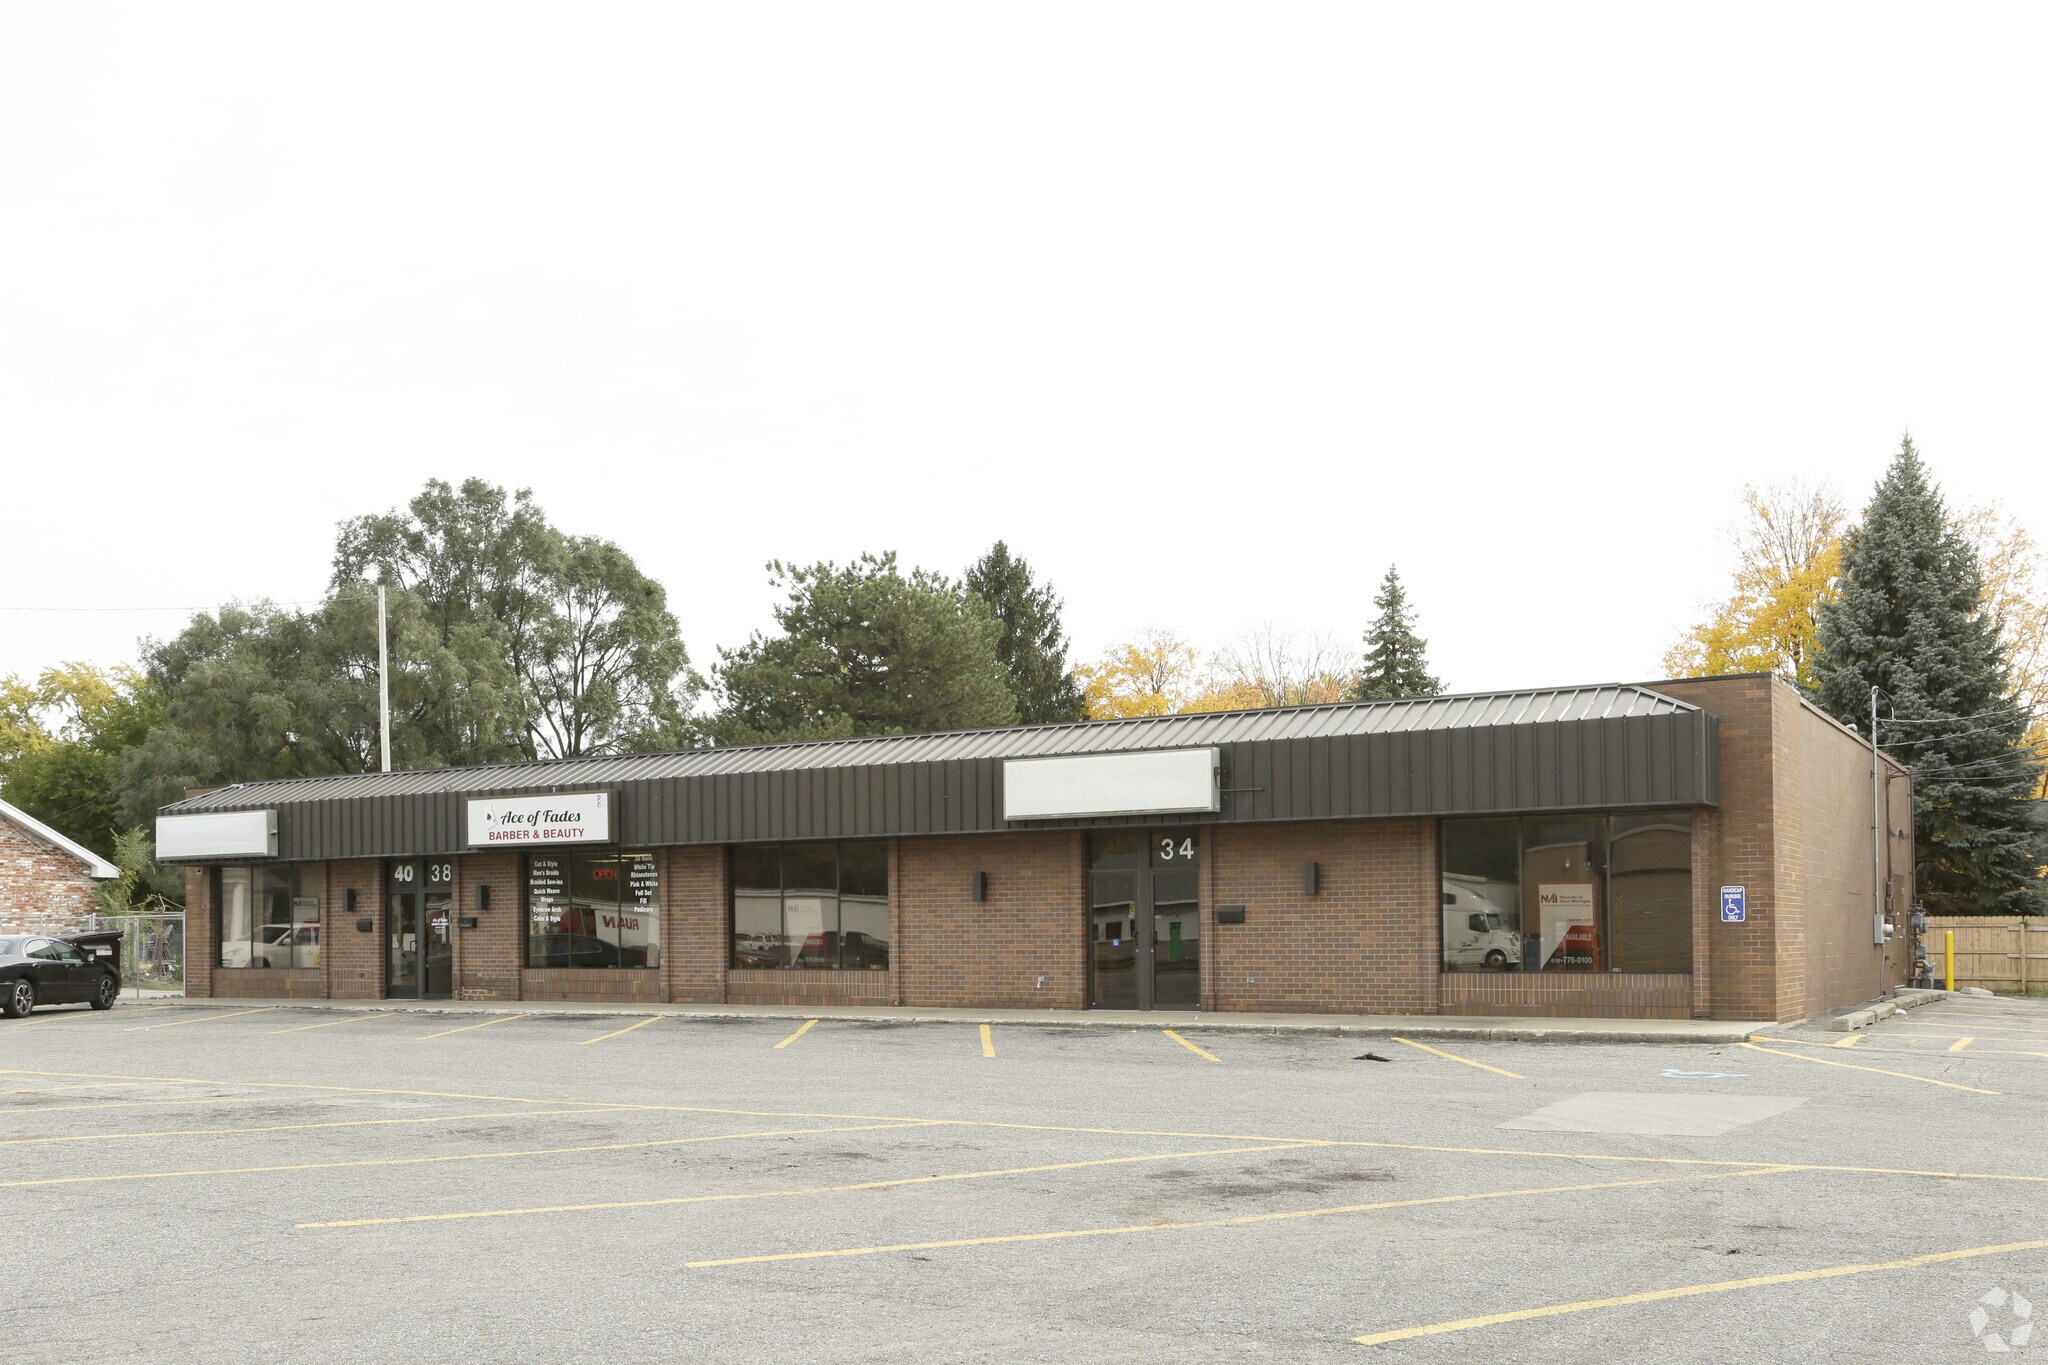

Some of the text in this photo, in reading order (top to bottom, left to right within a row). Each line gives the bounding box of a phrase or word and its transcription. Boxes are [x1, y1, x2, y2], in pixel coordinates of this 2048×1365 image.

[501, 809, 581, 826] Ace of Fades
[489, 828, 585, 841] BARBER & BEAUTY
[1160, 837, 1194, 860] 34
[394, 864, 451, 882] 40 38
[593, 869, 617, 879] OPEN
[1540, 892, 1558, 904] NAI
[550, 915, 561, 923] Style
[1565, 933, 1592, 941] AVAILABLE
